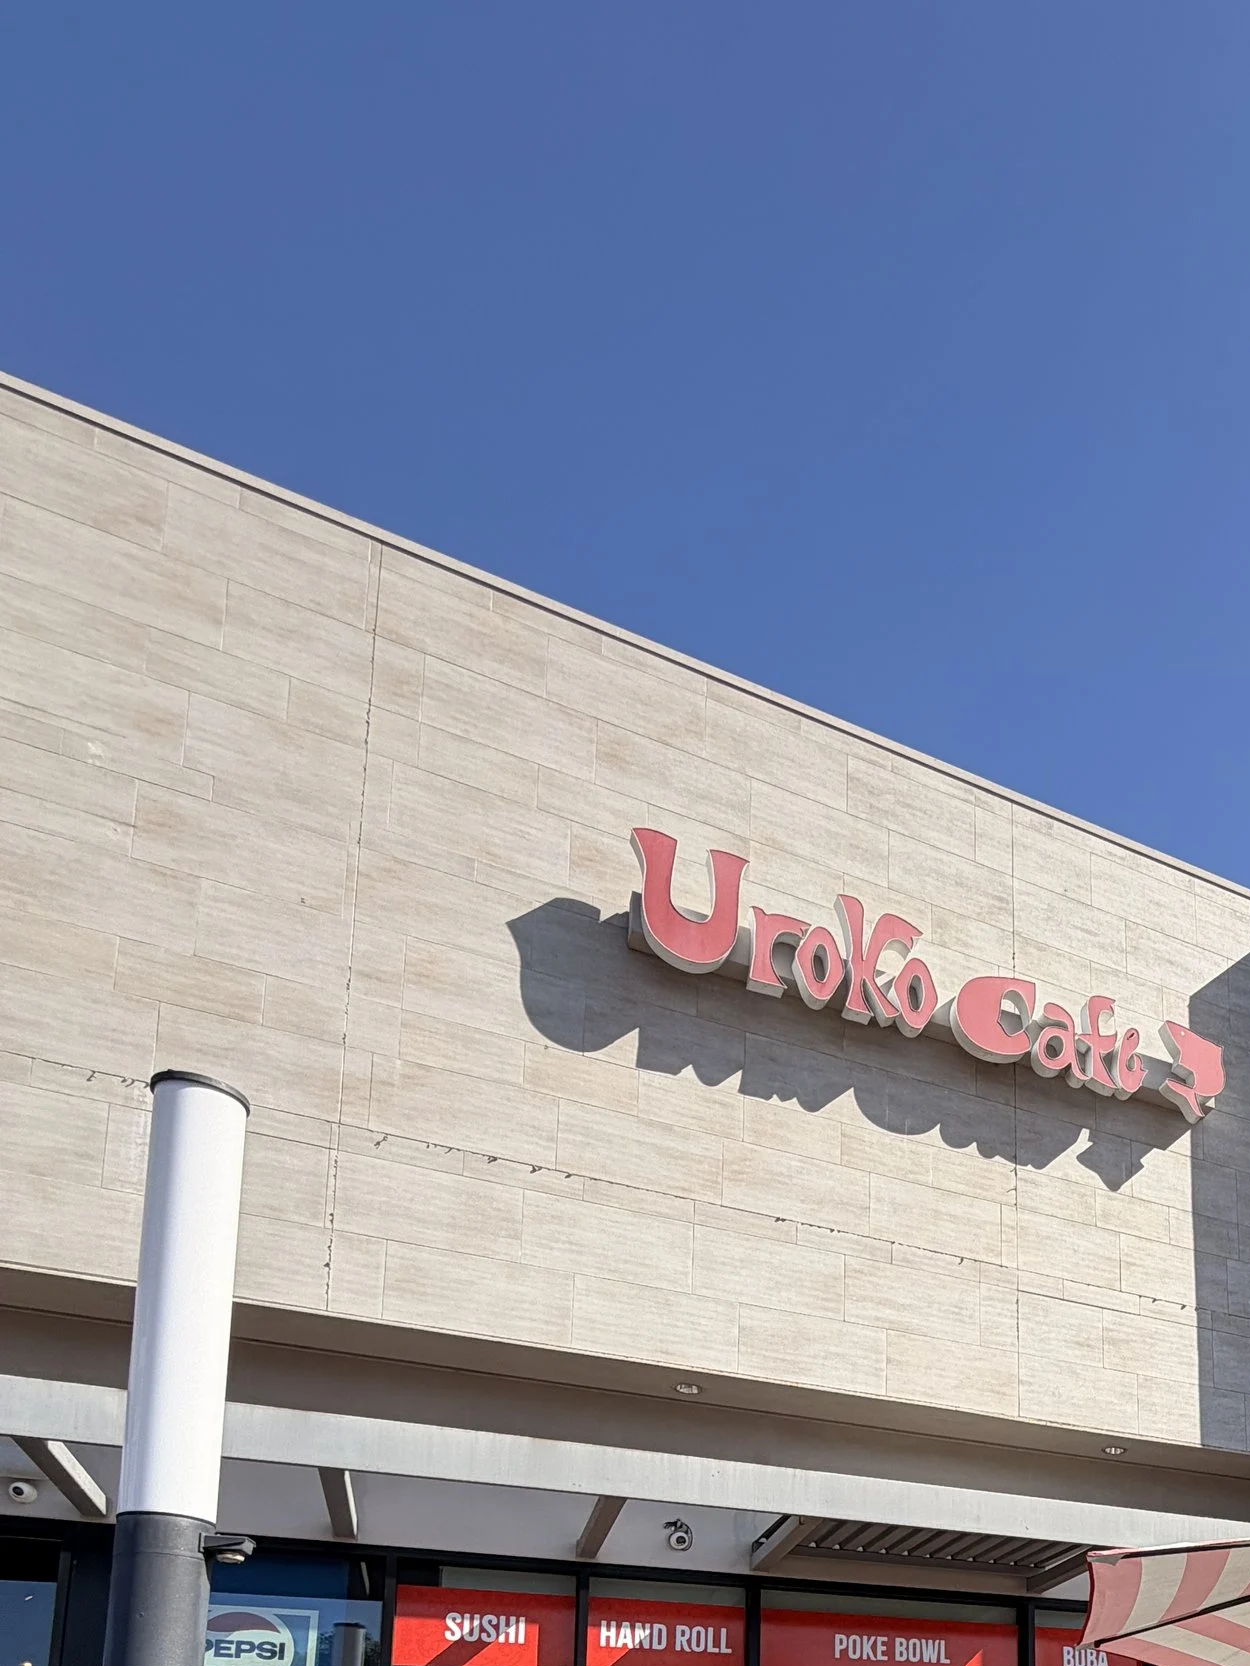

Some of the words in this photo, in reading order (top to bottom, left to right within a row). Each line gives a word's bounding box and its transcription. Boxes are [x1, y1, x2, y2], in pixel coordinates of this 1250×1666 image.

[953, 976, 1149, 1096] Cafe
[444, 1612, 526, 1645] SUSHI
[600, 1620, 667, 1650] HAND
[675, 1625, 732, 1654] ROLL
[834, 1634, 888, 1662] POKE
[895, 1638, 950, 1665] BOWL
